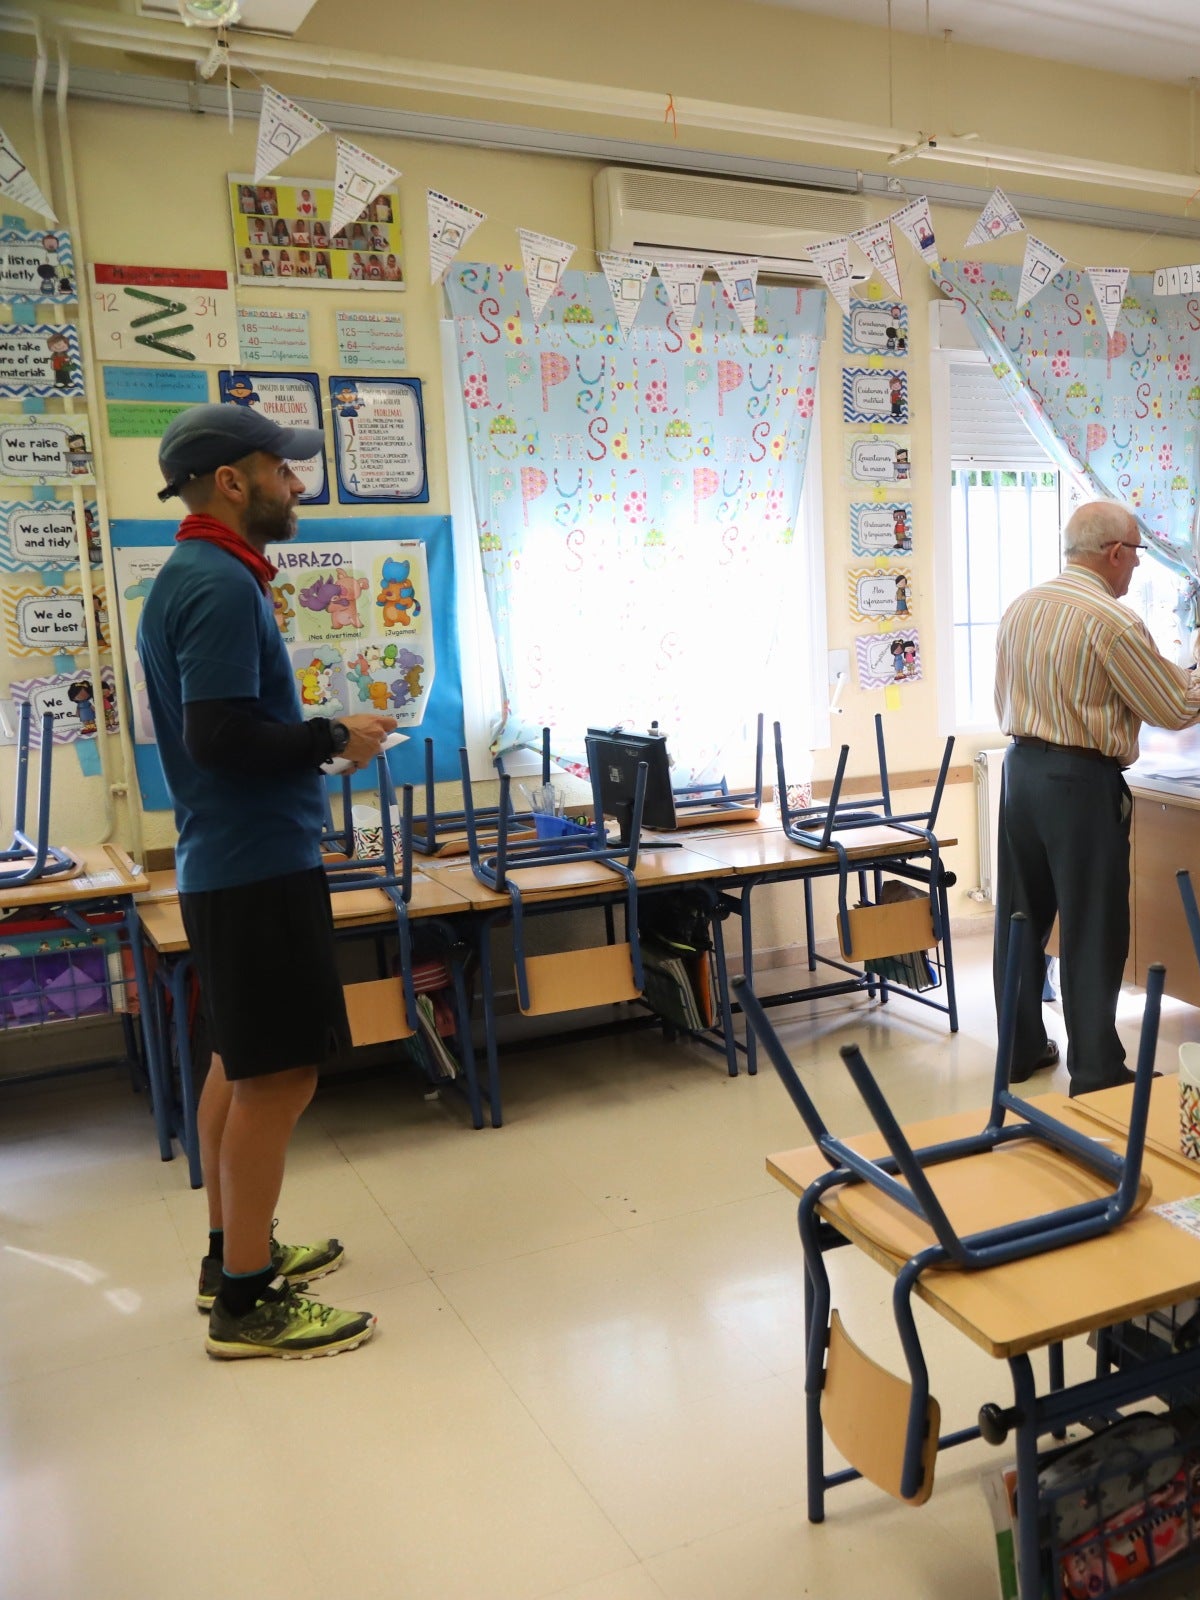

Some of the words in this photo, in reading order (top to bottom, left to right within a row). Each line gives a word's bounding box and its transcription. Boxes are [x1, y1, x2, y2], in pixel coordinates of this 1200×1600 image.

[8, 256, 40, 266] listen
[1158, 277, 1163, 287] 0
[1172, 274, 1175, 285] 1
[1184, 272, 1189, 284] 2
[1196, 271, 1200, 283] 3
[96, 293, 119, 312] 92
[195, 296, 216, 316] 34
[242, 324, 258, 332] 185
[858, 319, 887, 328] Escuchamos
[341, 328, 356, 336] 125
[370, 328, 403, 337] Sumando
[111, 332, 122, 348] 9
[206, 333, 227, 348] 18
[248, 337, 259, 346] 40
[347, 341, 357, 349] 64
[18, 341, 41, 351] take
[18, 355, 30, 364] of
[244, 351, 260, 360] 145
[344, 355, 358, 364] 189
[1, 369, 45, 377] materials
[858, 386, 883, 395] Cuidamos
[264, 403, 307, 414] OPERACIONES
[6, 439, 25, 448] We
[30, 439, 58, 448] raise
[344, 435, 356, 452] 2
[8, 454, 28, 462] our
[33, 452, 61, 462] hand
[349, 454, 357, 470] 3
[858, 453, 891, 462] Levantamos
[349, 473, 360, 491] 4
[20, 525, 39, 534] We
[43, 524, 72, 533] clean
[25, 538, 45, 547] and
[48, 537, 70, 548] tidy
[872, 587, 884, 595] Nos
[34, 610, 53, 619] We
[57, 609, 72, 619] do
[31, 624, 50, 633] our
[54, 622, 78, 632] best
[385, 629, 416, 637] ¡Jugamos!
[43, 698, 62, 708] We
